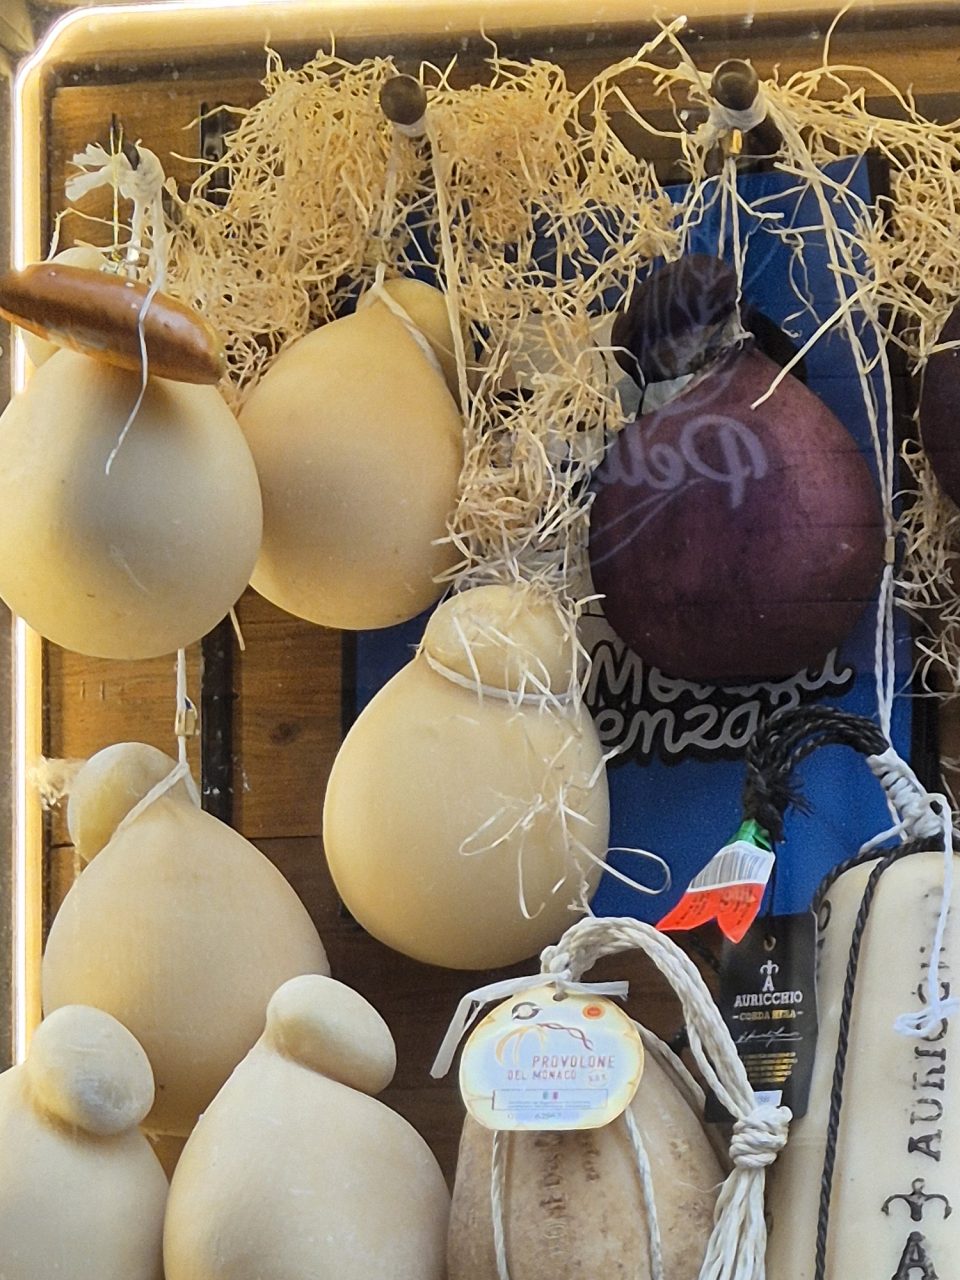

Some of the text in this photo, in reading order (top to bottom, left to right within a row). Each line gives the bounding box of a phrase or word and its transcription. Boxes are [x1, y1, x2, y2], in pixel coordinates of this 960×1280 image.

[734, 990, 803, 1008] AURICCHIO
[532, 1055, 616, 1069] PROVOLONE
[507, 1071, 527, 1081] DEL
[532, 1070, 578, 1081] MONACO
